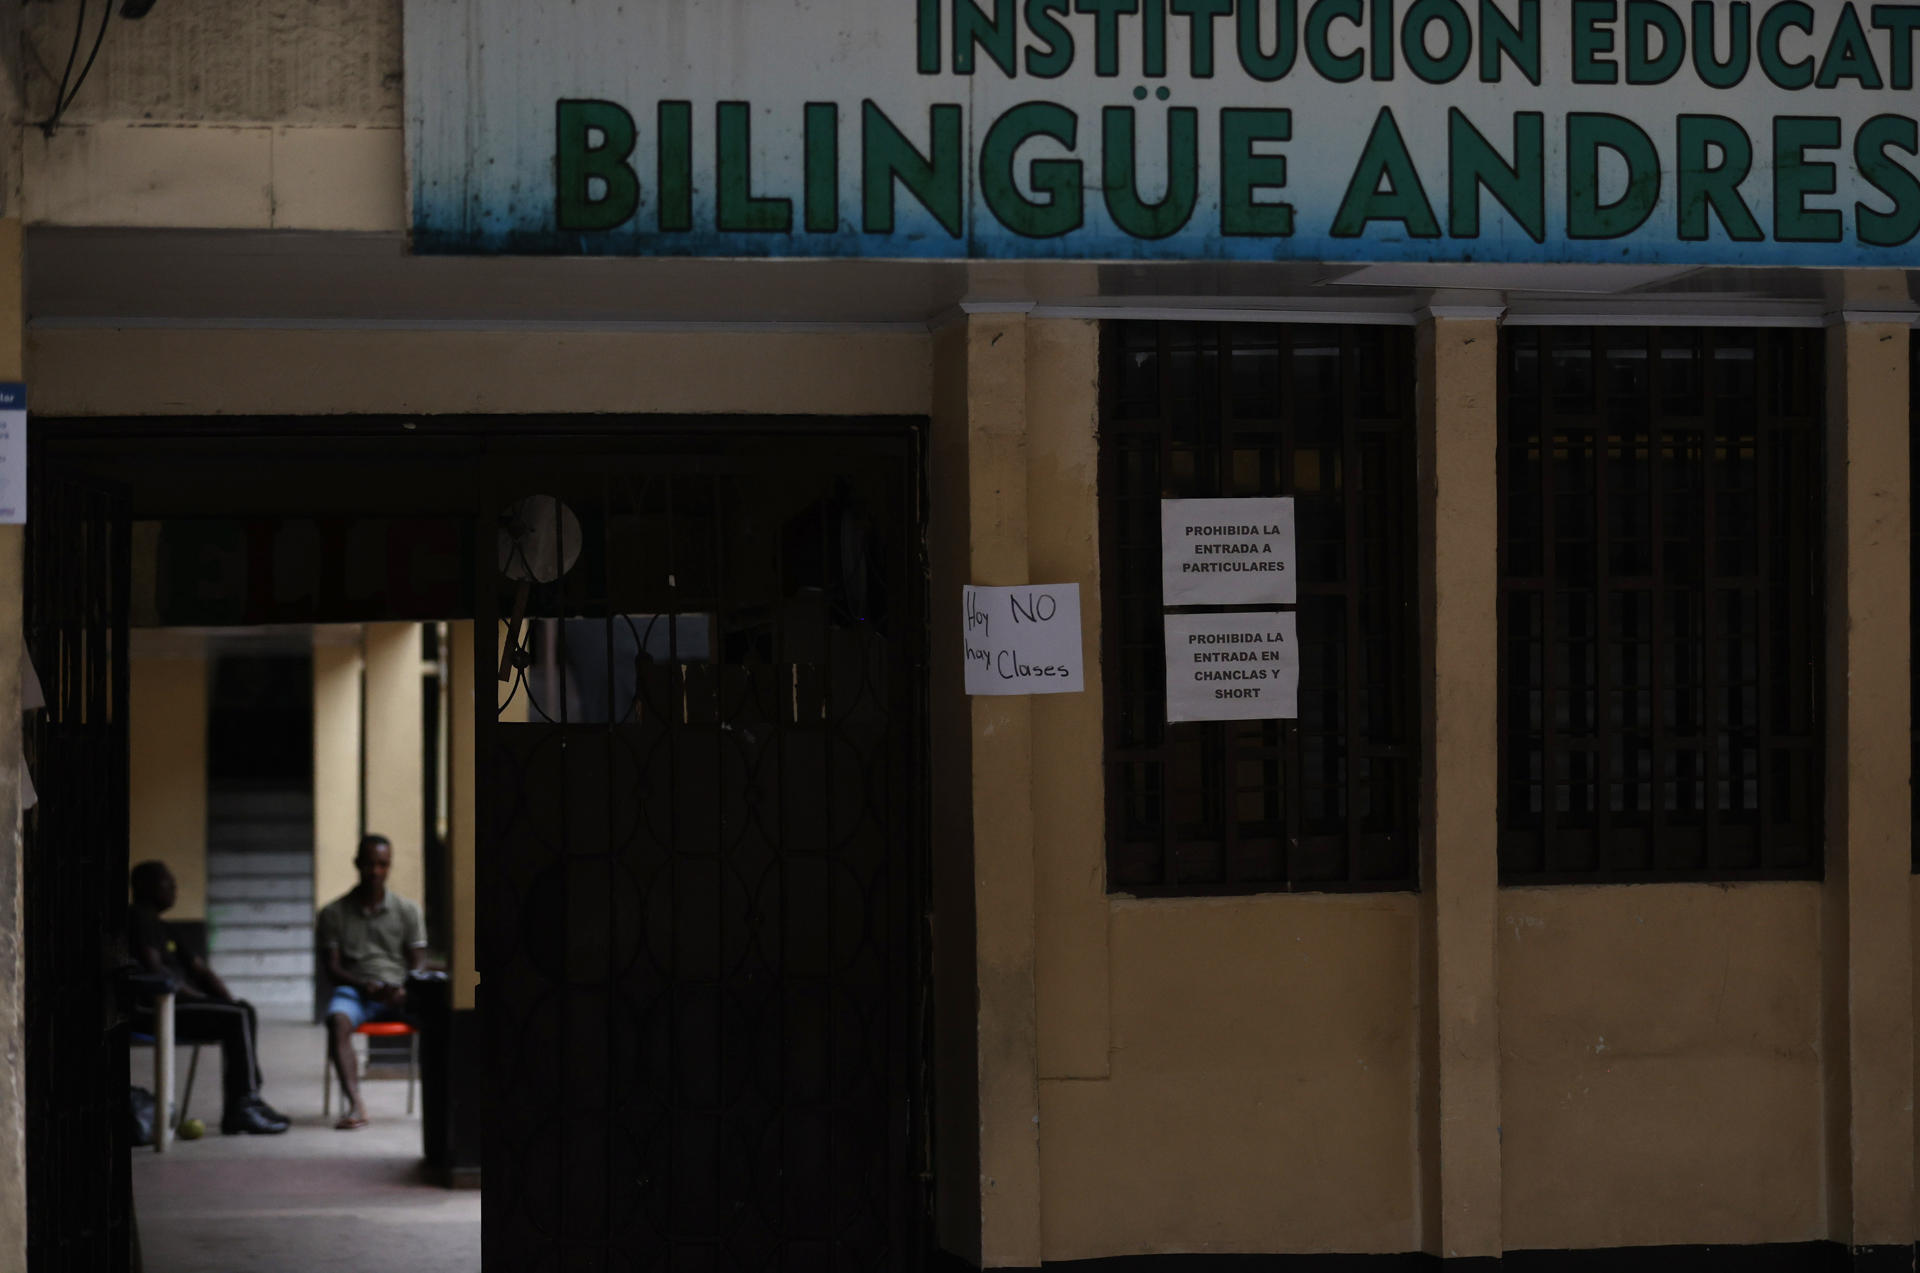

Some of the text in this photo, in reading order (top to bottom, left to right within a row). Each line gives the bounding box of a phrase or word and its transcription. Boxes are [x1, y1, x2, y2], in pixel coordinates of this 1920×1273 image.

[916, 0, 1541, 86] INSTITUCION
[556, 85, 1920, 247] BILINGÜE ANDRES
[1185, 525, 1280, 536] PROHIBIDA LA
[1194, 543, 1272, 554] ENTRADA A
[1182, 561, 1285, 573] PARTICULARES
[966, 591, 1056, 637] Hoy NO
[1188, 632, 1284, 644] PROHIBIDA LA
[965, 638, 1069, 680] hay Clases
[1194, 651, 1280, 662] ENTRADA EN
[1194, 669, 1281, 681] CHANCLAS Y
[1215, 688, 1261, 699] SHORT
